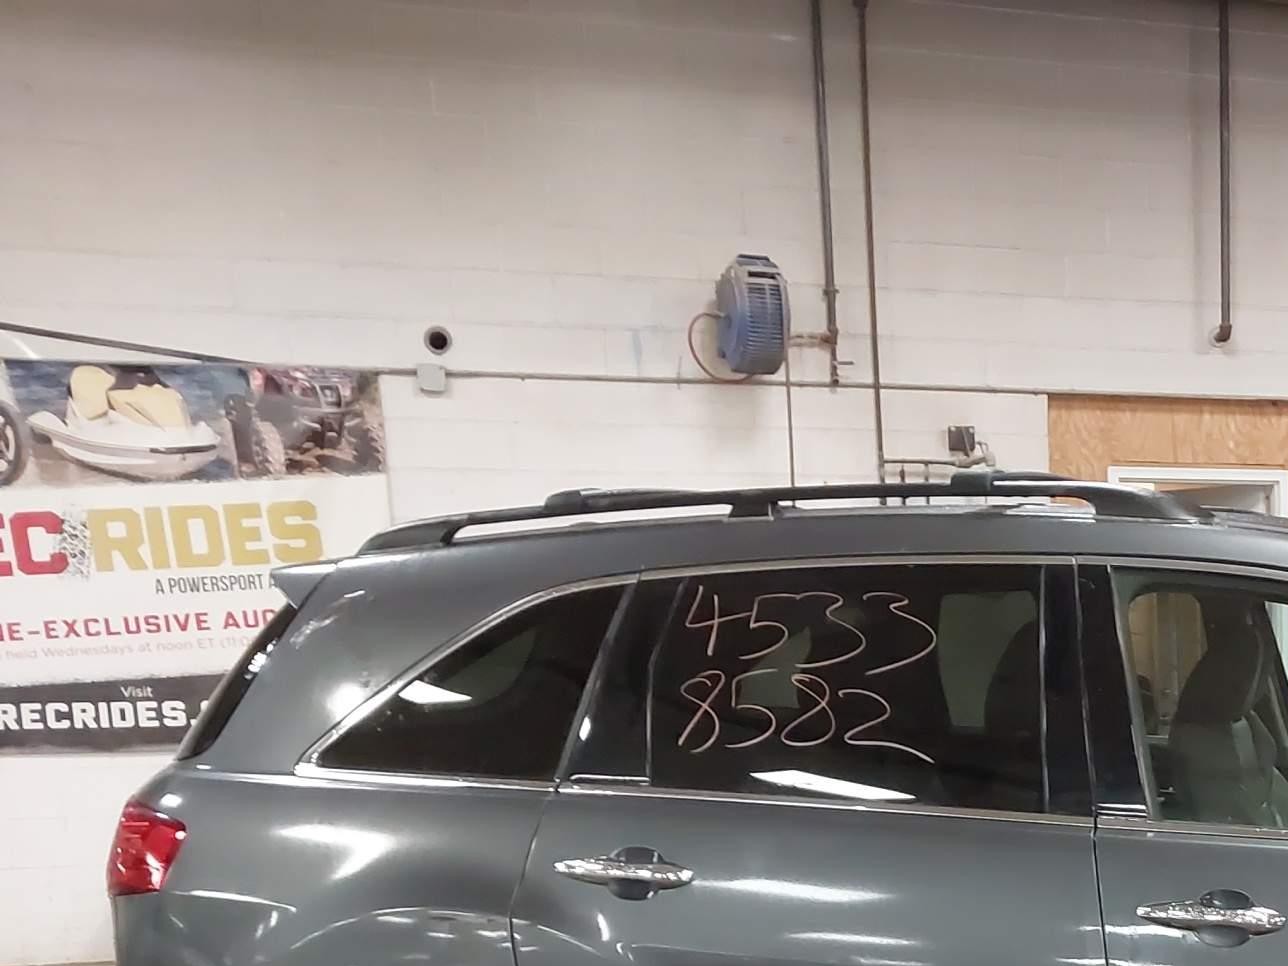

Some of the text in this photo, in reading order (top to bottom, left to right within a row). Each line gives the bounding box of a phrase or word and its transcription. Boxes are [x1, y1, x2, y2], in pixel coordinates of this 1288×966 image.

[87, 501, 324, 572] RIDES
[155, 578, 164, 594] A
[169, 574, 264, 593] POWERSPORT
[0, 612, 210, 641] E-EXCLUSIVE
[686, 586, 937, 675] 4533
[41, 640, 133, 658] Wednesdays
[138, 643, 152, 653] at
[158, 641, 192, 651] noon
[197, 637, 215, 649] ET
[120, 685, 153, 698] Visit
[0, 699, 208, 731] RECRIDES.
[678, 670, 936, 763] 8582
